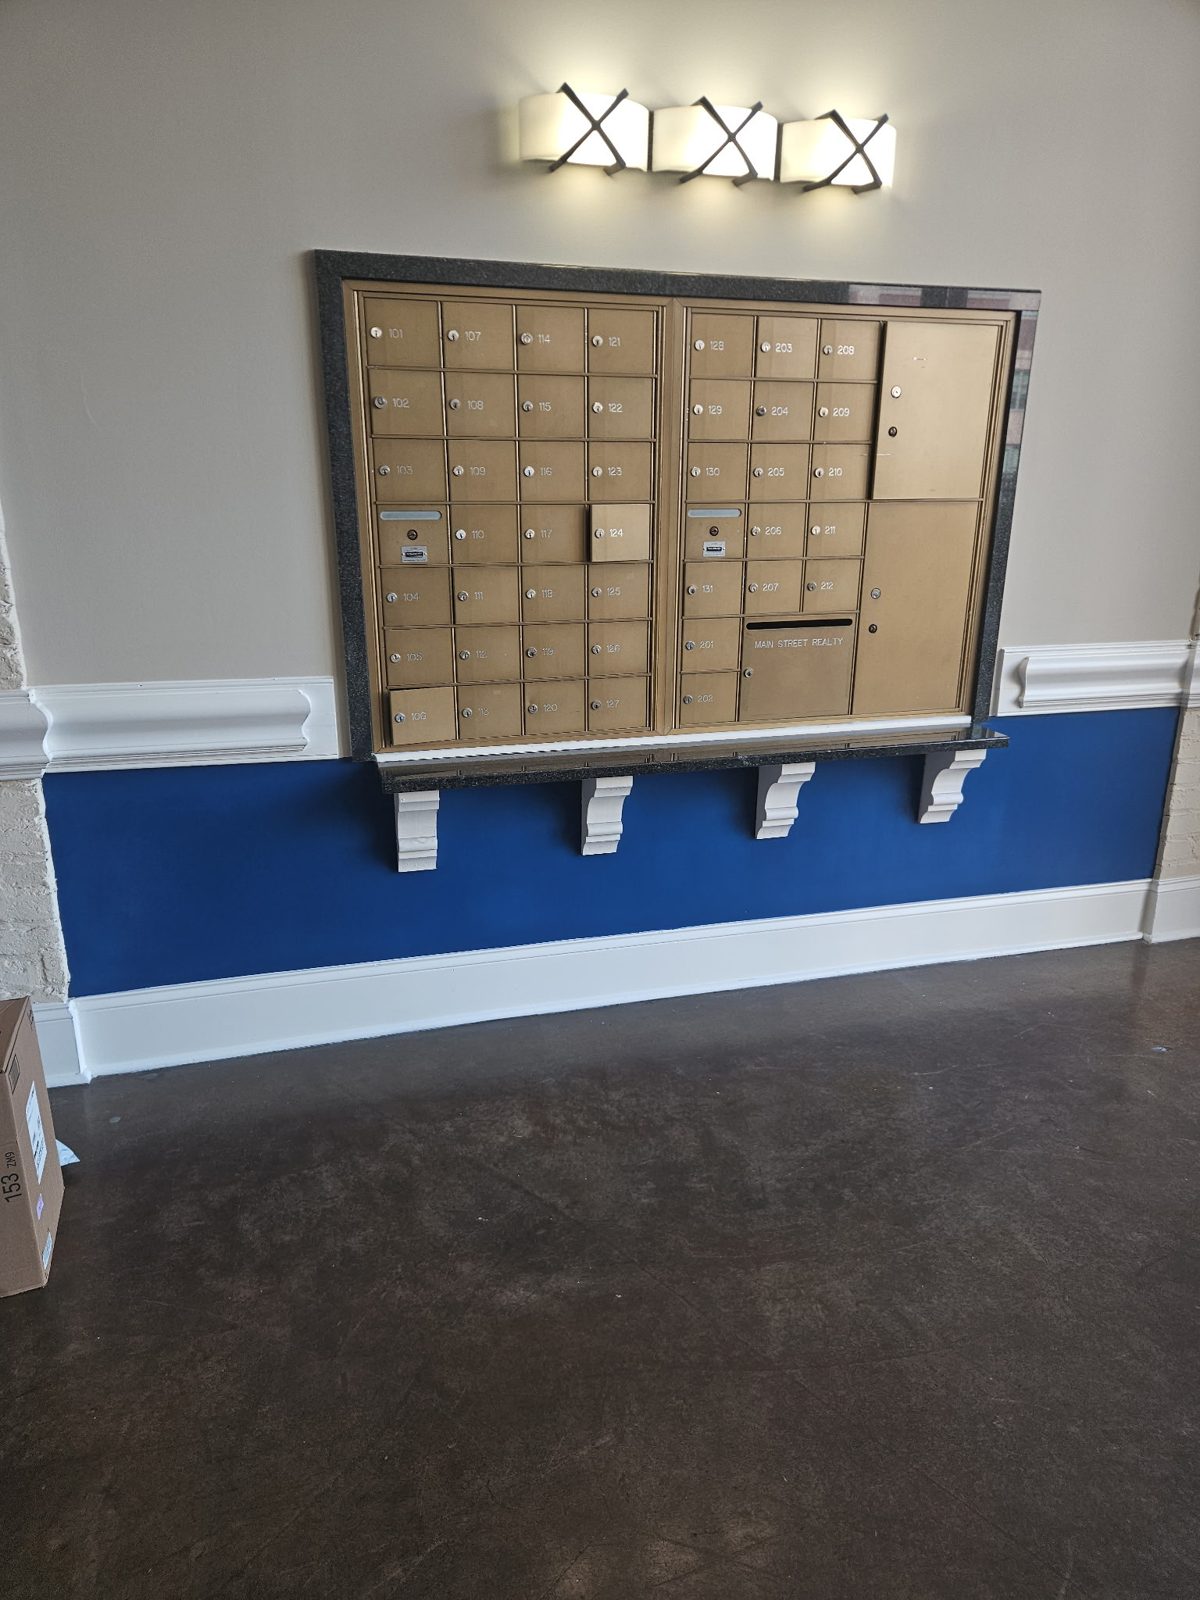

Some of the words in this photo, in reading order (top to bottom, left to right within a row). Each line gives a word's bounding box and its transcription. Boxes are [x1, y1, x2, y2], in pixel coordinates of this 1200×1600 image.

[388, 328, 403, 338] 101
[464, 331, 481, 341] 107
[538, 334, 551, 343] 114
[608, 337, 620, 347] 121
[775, 343, 793, 353] 203
[837, 345, 855, 355] 208
[392, 398, 410, 408] 102
[467, 400, 484, 410] 108
[539, 402, 551, 411] 115
[608, 403, 623, 413] 122
[708, 405, 722, 414] 129
[771, 406, 789, 416] 204
[833, 407, 850, 417] 209
[396, 465, 413, 474] 103
[469, 466, 486, 476] 109
[540, 467, 552, 476] 116
[608, 467, 622, 476] 123
[706, 468, 720, 476] 130
[768, 468, 784, 476] 205
[828, 468, 842, 476] 210
[472, 530, 484, 539] 110
[609, 529, 623, 537] 124
[765, 527, 782, 535] 206
[825, 526, 835, 535] 211
[762, 583, 779, 591] 207
[820, 582, 833, 590] 212
[607, 587, 621, 596] 125
[403, 592, 420, 601] 104
[700, 641, 714, 649] 201
[754, 640, 774, 648] MAIN
[778, 639, 808, 647] STREET
[812, 637, 844, 646] REALTY
[543, 704, 557, 712] 120
[1, 1174, 22, 1202] 153
